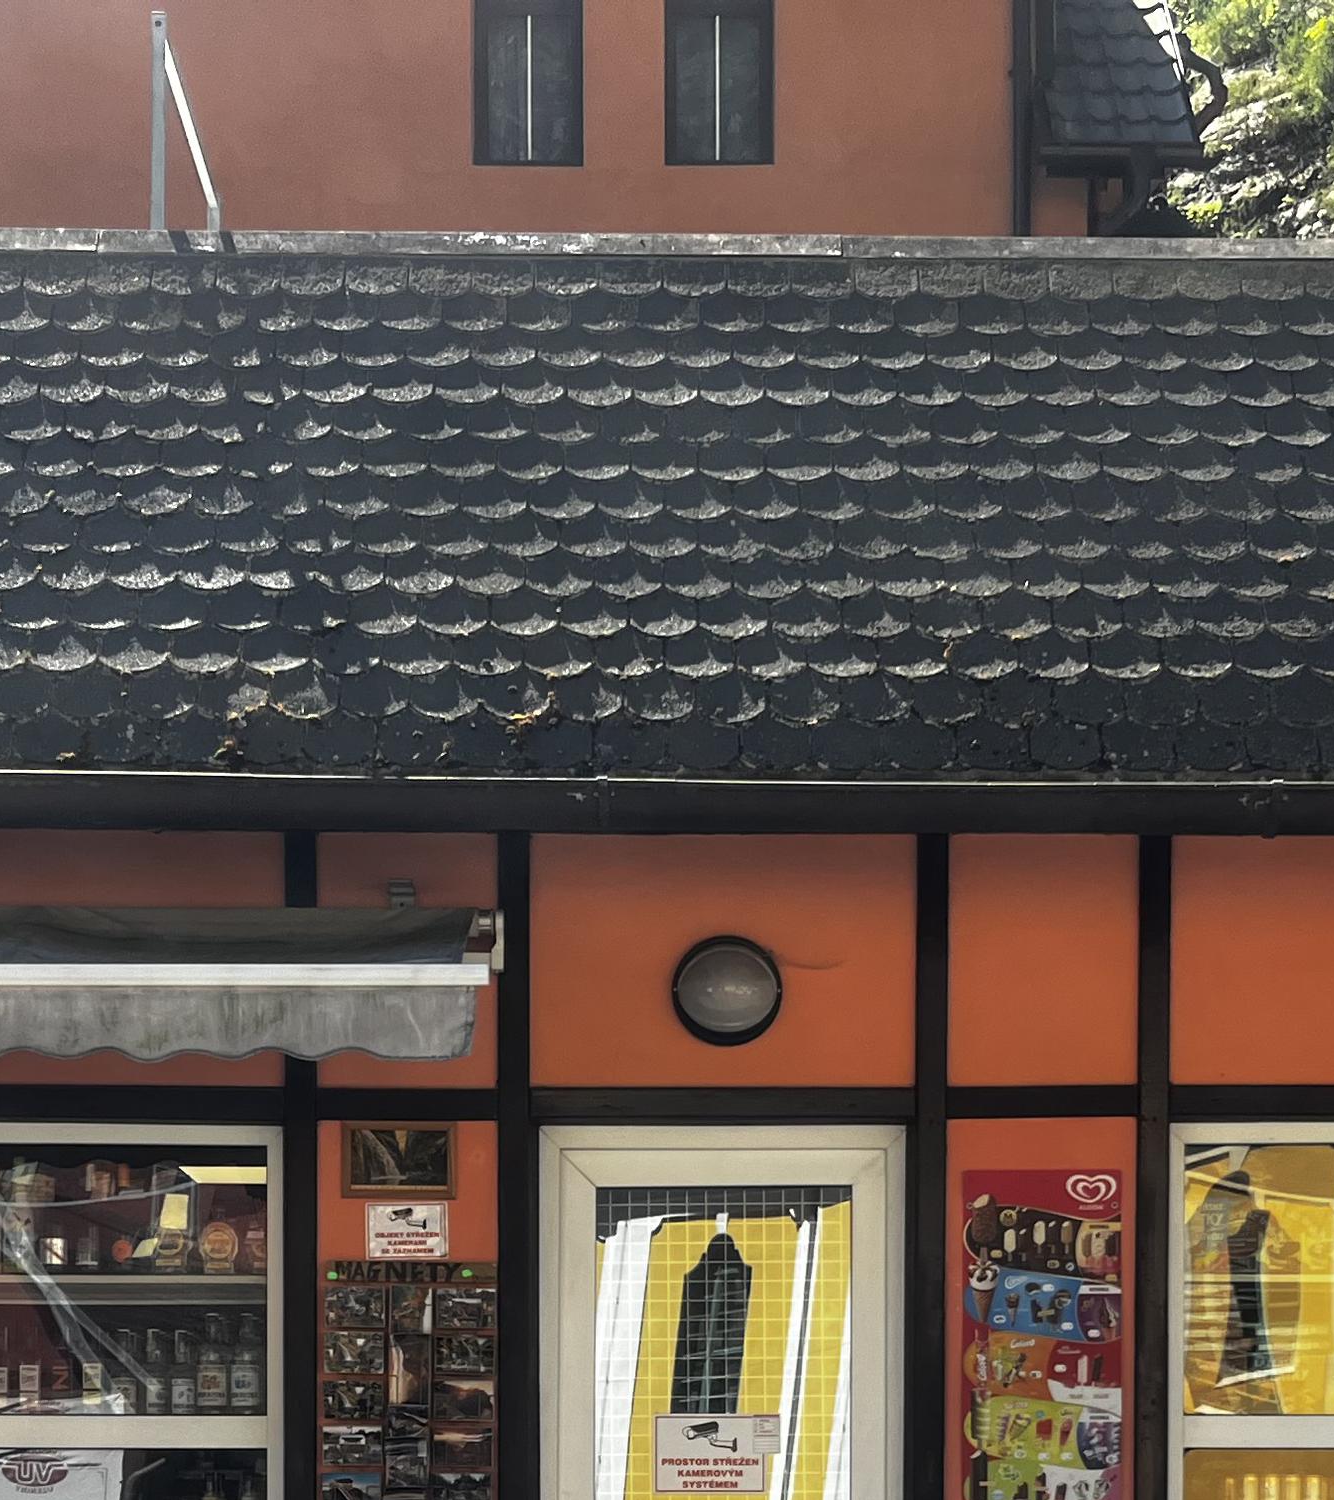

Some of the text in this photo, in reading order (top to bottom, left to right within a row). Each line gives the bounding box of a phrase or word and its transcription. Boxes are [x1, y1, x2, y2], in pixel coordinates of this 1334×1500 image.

[335, 1261, 461, 1281] MAGNETY
[661, 1456, 759, 1466] PROSTOR STŘEŽEN
[677, 1468, 743, 1477] KAMEROVÝM
[682, 1479, 738, 1488] SYSTÉMEM
